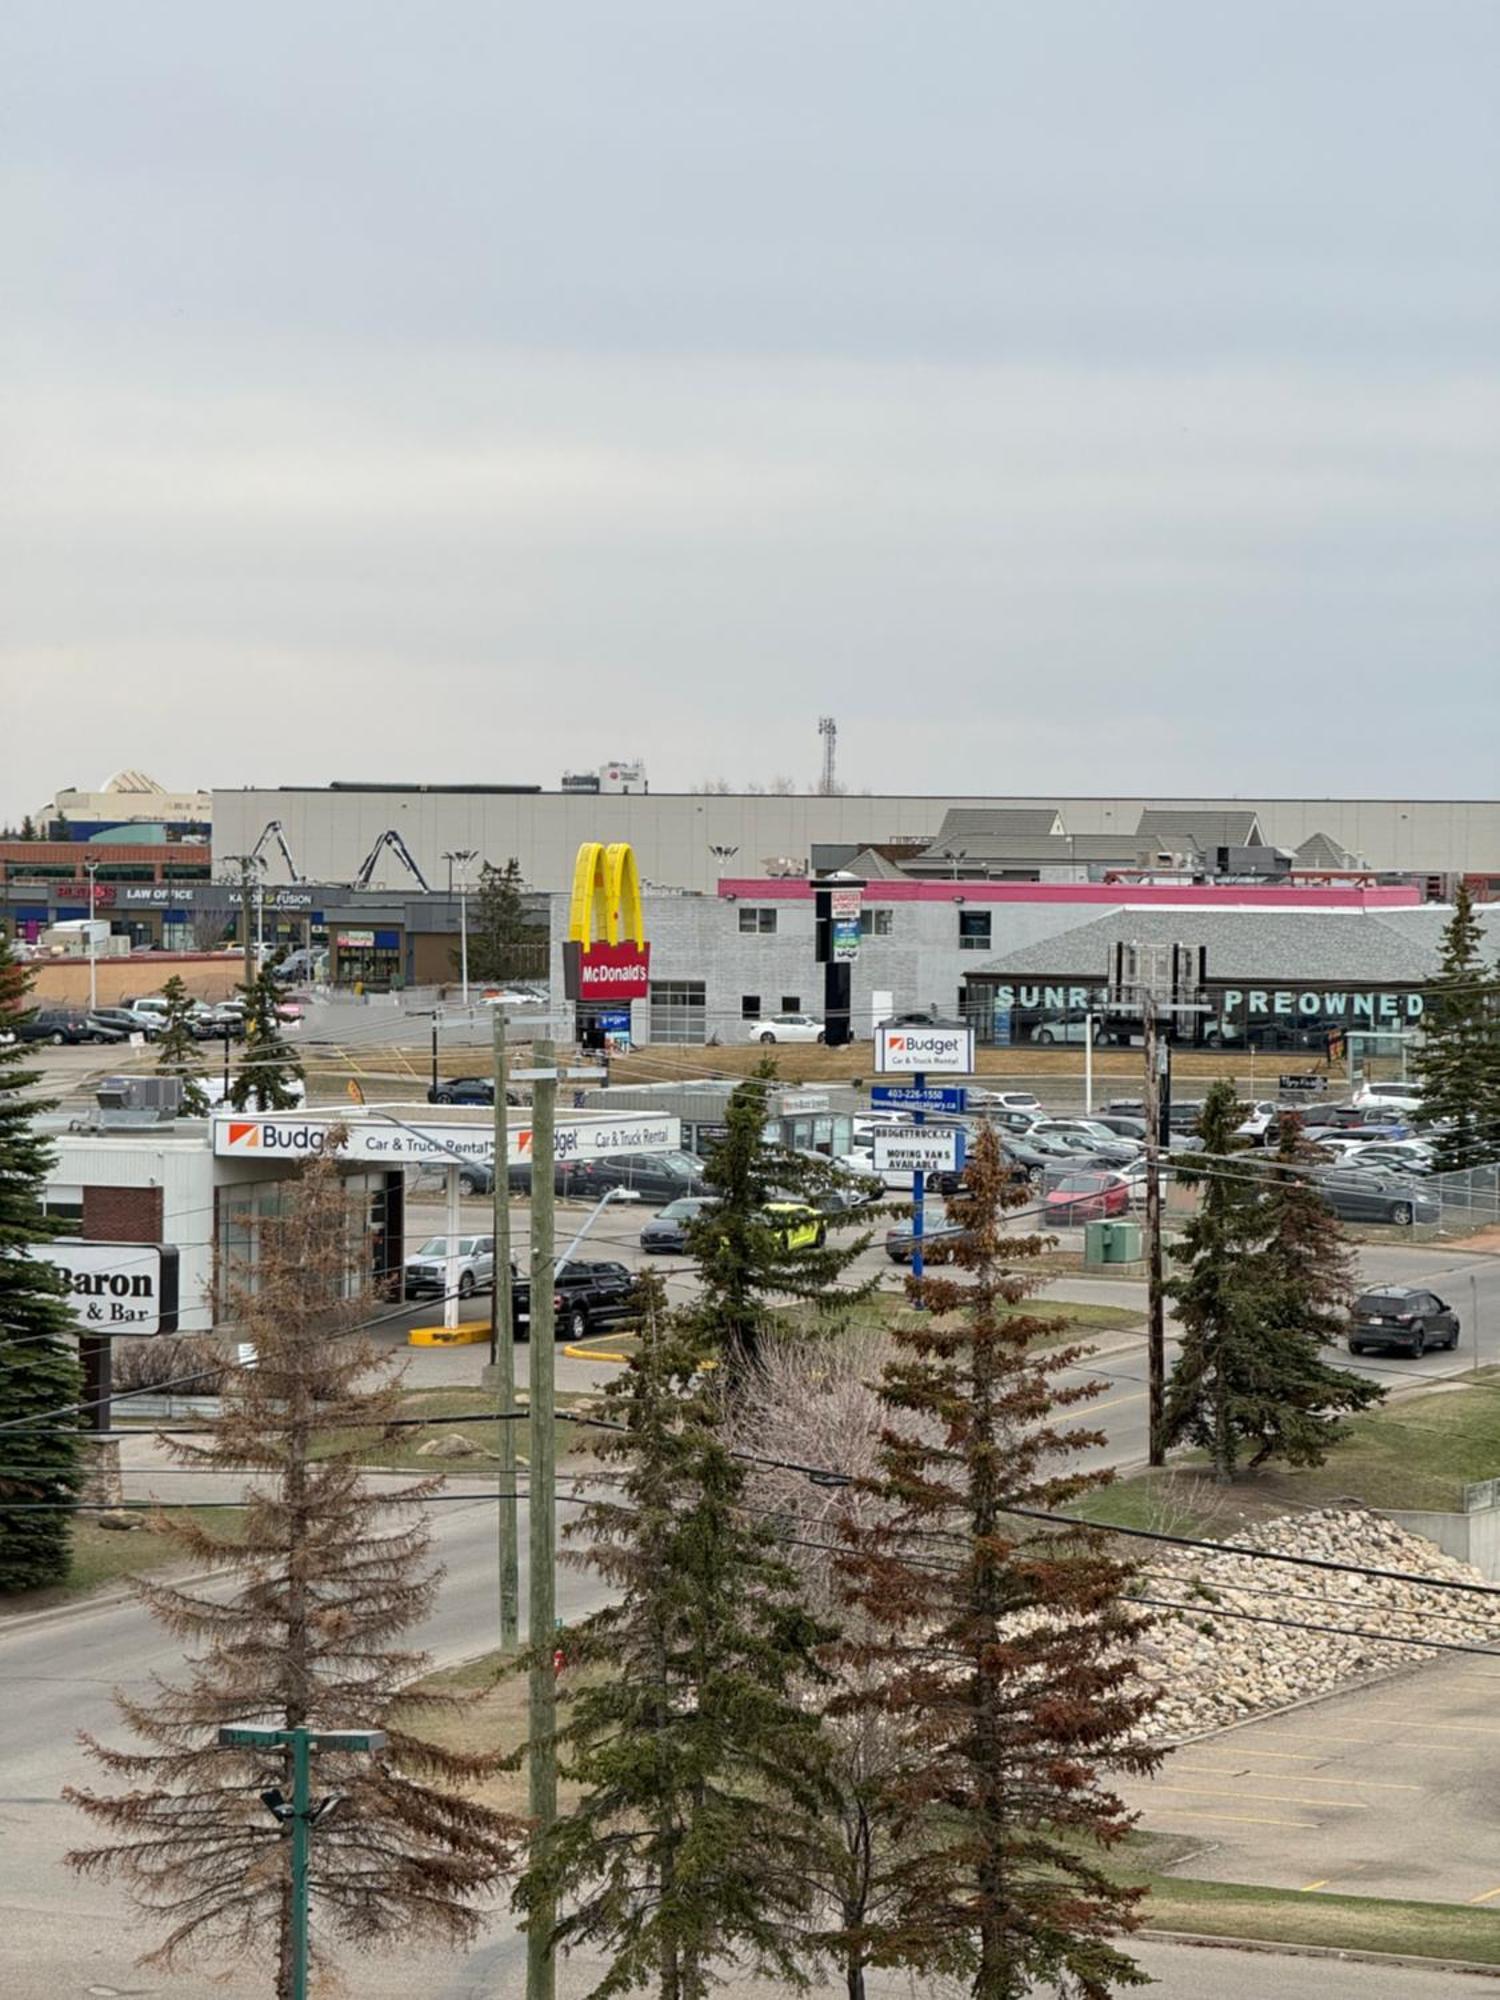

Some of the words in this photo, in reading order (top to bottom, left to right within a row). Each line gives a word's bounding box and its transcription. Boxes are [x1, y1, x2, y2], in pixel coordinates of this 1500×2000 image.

[127, 889, 151, 899] LAW
[153, 889, 193, 900] OFICE
[229, 893, 263, 904] KAOB
[276, 893, 312, 905] FUSION
[582, 965, 647, 982] McDonald's
[1224, 990, 1425, 1017] PREOWNED
[906, 1036, 959, 1055] Budget
[892, 1056, 904, 1065] Car
[905, 1056, 911, 1065] &
[912, 1056, 932, 1065] Truck
[933, 1056, 959, 1065] Rental
[262, 1125, 349, 1155] Budg
[365, 1136, 389, 1151] Car
[391, 1138, 403, 1151] &
[553, 1127, 578, 1159] dget
[595, 1132, 609, 1148] Car
[611, 1132, 619, 1147] &
[620, 1129, 642, 1146] Truck
[643, 1126, 669, 1144] Rental
[887, 1149, 921, 1159] MOVING
[888, 1160, 938, 1169] AVAILABLE
[86, 1301, 104, 1321] &
[109, 1302, 149, 1322] Bar
